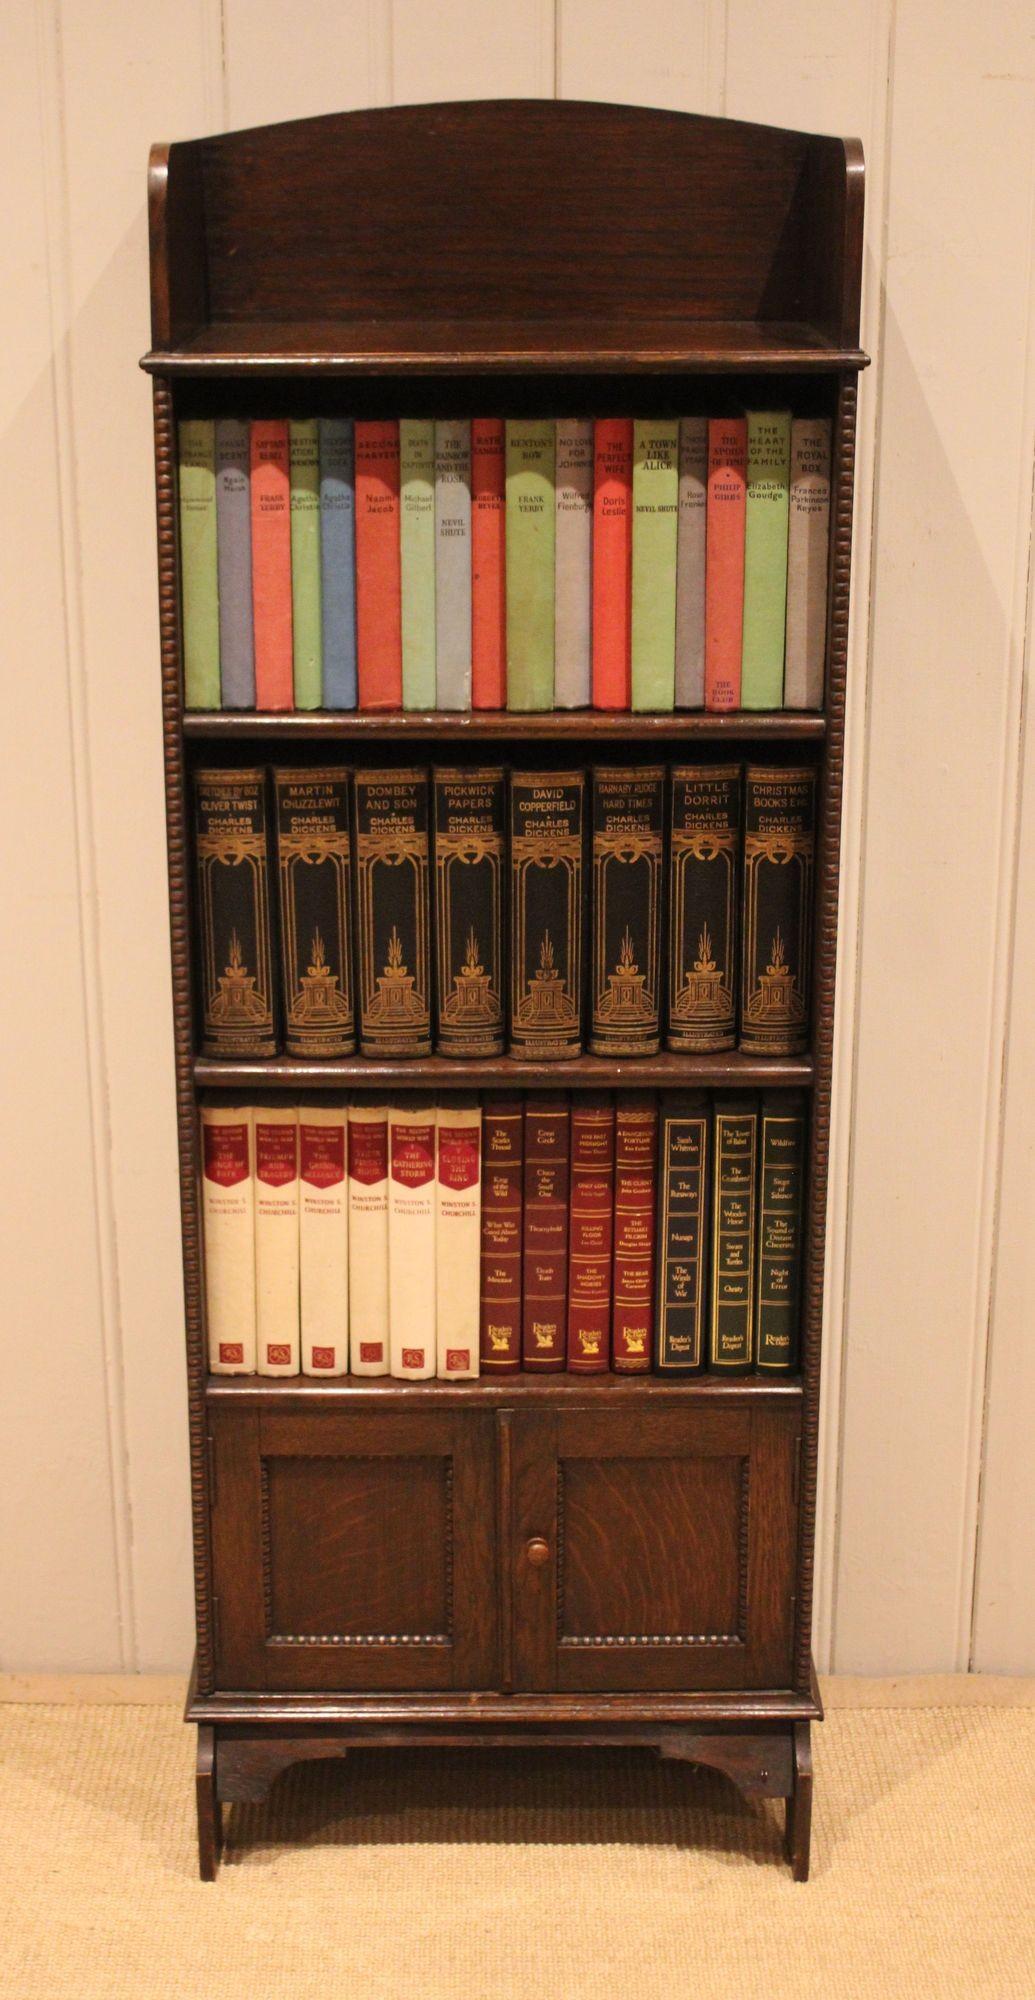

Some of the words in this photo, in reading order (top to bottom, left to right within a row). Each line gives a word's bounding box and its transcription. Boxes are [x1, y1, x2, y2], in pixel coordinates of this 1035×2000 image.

[757, 426, 778, 434] THE
[607, 442, 623, 451] THE
[640, 441, 646, 449] A
[650, 440, 677, 449] TOWN
[803, 439, 822, 448] THE
[569, 450, 585, 458] FOR
[647, 451, 669, 460] LIKE
[797, 450, 828, 460] ROYAL
[802, 463, 821, 473] BOX
[603, 496, 625, 505] Doris
[367, 504, 394, 513] Jacob
[290, 786, 333, 796] MARTIN
[367, 786, 416, 796] DOMBEY
[445, 786, 495, 796] PICKWICK
[685, 782, 730, 793] LITTLE
[752, 785, 808, 796] CHRISTMAS
[533, 789, 564, 799] DAVID
[366, 800, 390, 809] AND
[393, 799, 417, 809] SON
[448, 799, 493, 808] PAPERS
[603, 799, 625, 809] HARD
[628, 798, 653, 808] TIMES
[684, 795, 730, 806] DORRIT
[754, 798, 788, 808] BOOKS
[519, 801, 576, 812] COPPERFIELD
[208, 817, 252, 825] CHARLES
[291, 816, 335, 824] CHARLES
[370, 816, 414, 825] CHARLES
[448, 816, 493, 824] CHARLES
[606, 815, 650, 823] CHARLES
[684, 812, 728, 821] CHARLES
[758, 816, 802, 824] CHARLES
[525, 819, 569, 828] CHARLES
[606, 824, 651, 832] DICKENS
[685, 821, 729, 829] DICKENS
[208, 826, 253, 834] DICKENS
[291, 825, 337, 834] DICKENS
[370, 826, 416, 834] DICKENS
[449, 825, 494, 833] DICKENS
[525, 829, 570, 837] DICKENS
